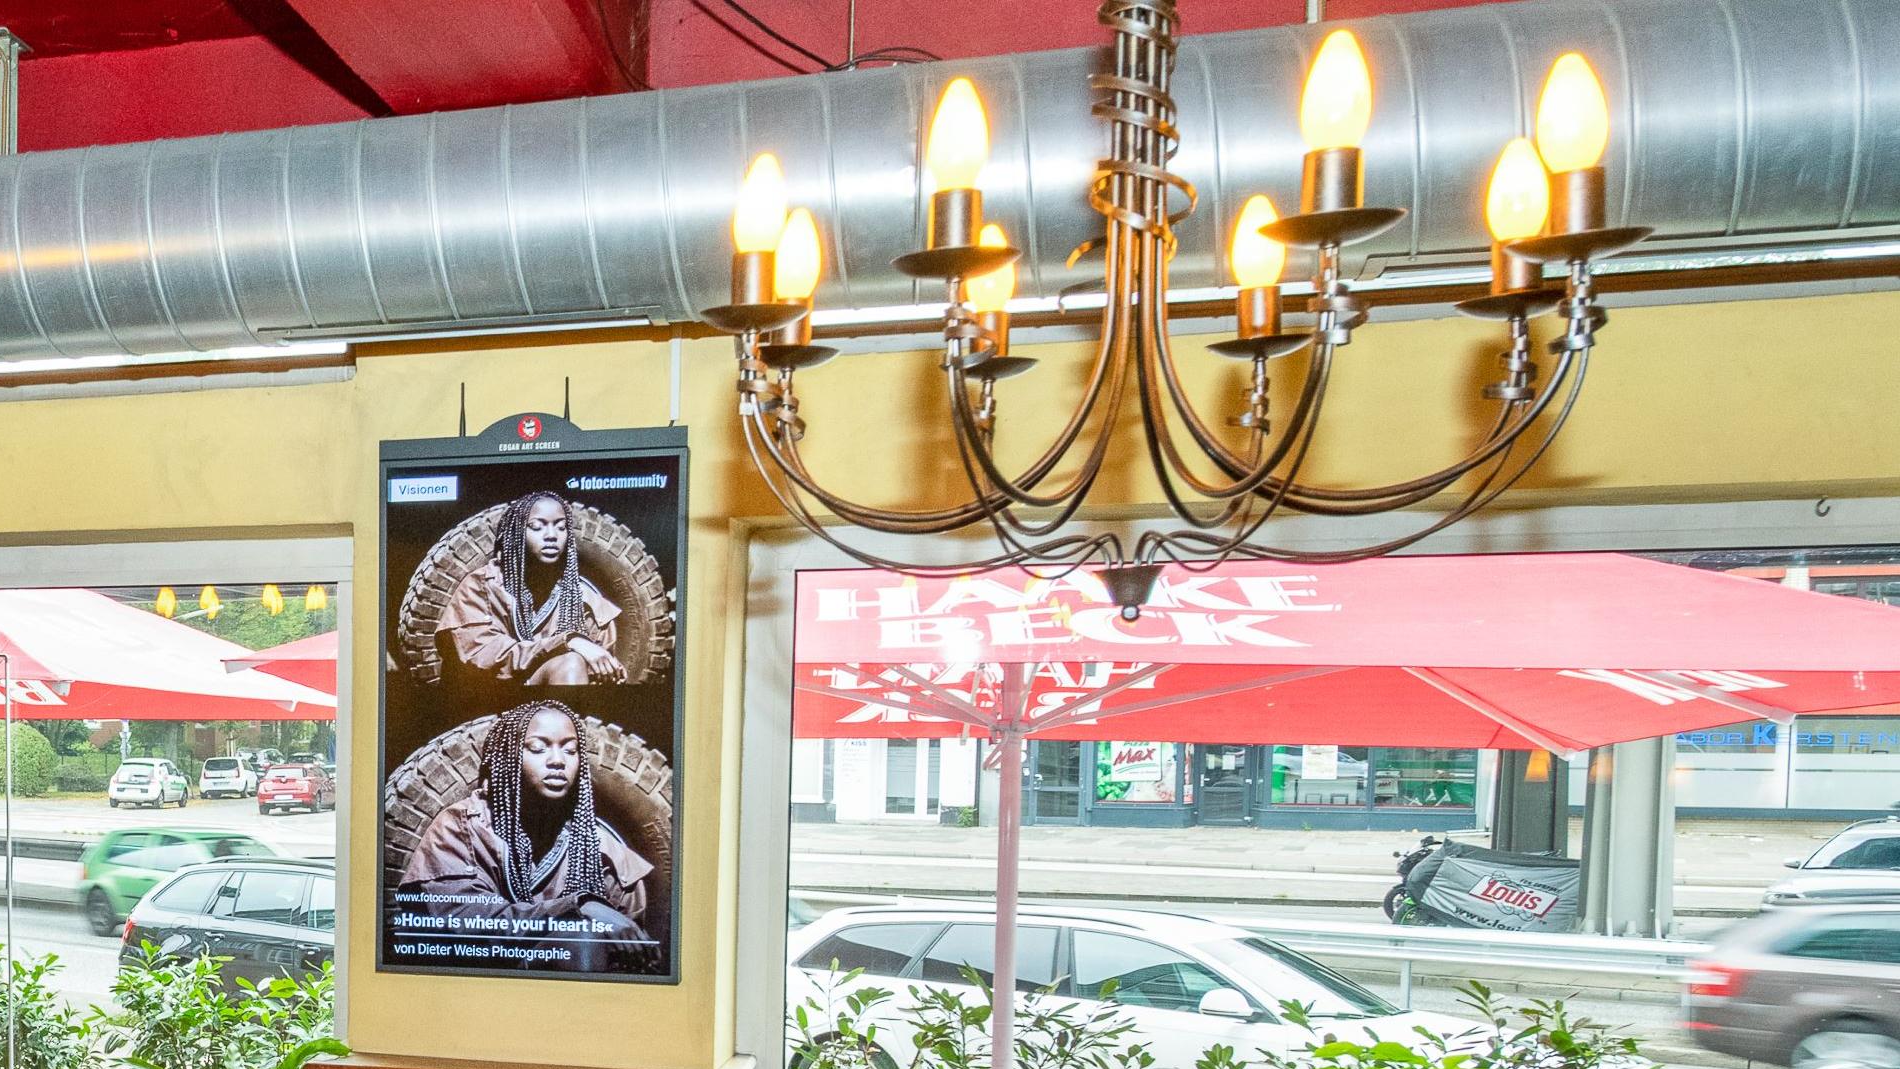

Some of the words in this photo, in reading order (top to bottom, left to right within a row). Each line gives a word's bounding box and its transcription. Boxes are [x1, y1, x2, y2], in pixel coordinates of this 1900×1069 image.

[498, 443, 520, 452] EDGAR
[521, 442, 534, 450] ART
[535, 441, 560, 450] SCREEN
[398, 483, 449, 497] Visionen
[580, 473, 669, 491] fotocommunity
[816, 567, 1343, 622] HAAKE
[877, 606, 1314, 649] BECK
[1112, 747, 1157, 766] Max
[394, 892, 504, 905] www.fotocommunity.de
[1481, 879, 1542, 910] Louis
[448, 914, 461, 929] is
[463, 915, 509, 930] where
[512, 919, 546, 934] your
[548, 916, 589, 932] heart
[394, 944, 416, 955] von
[417, 944, 452, 956] Dieter
[453, 944, 489, 957] Weiss
[491, 945, 571, 961] Photographie
